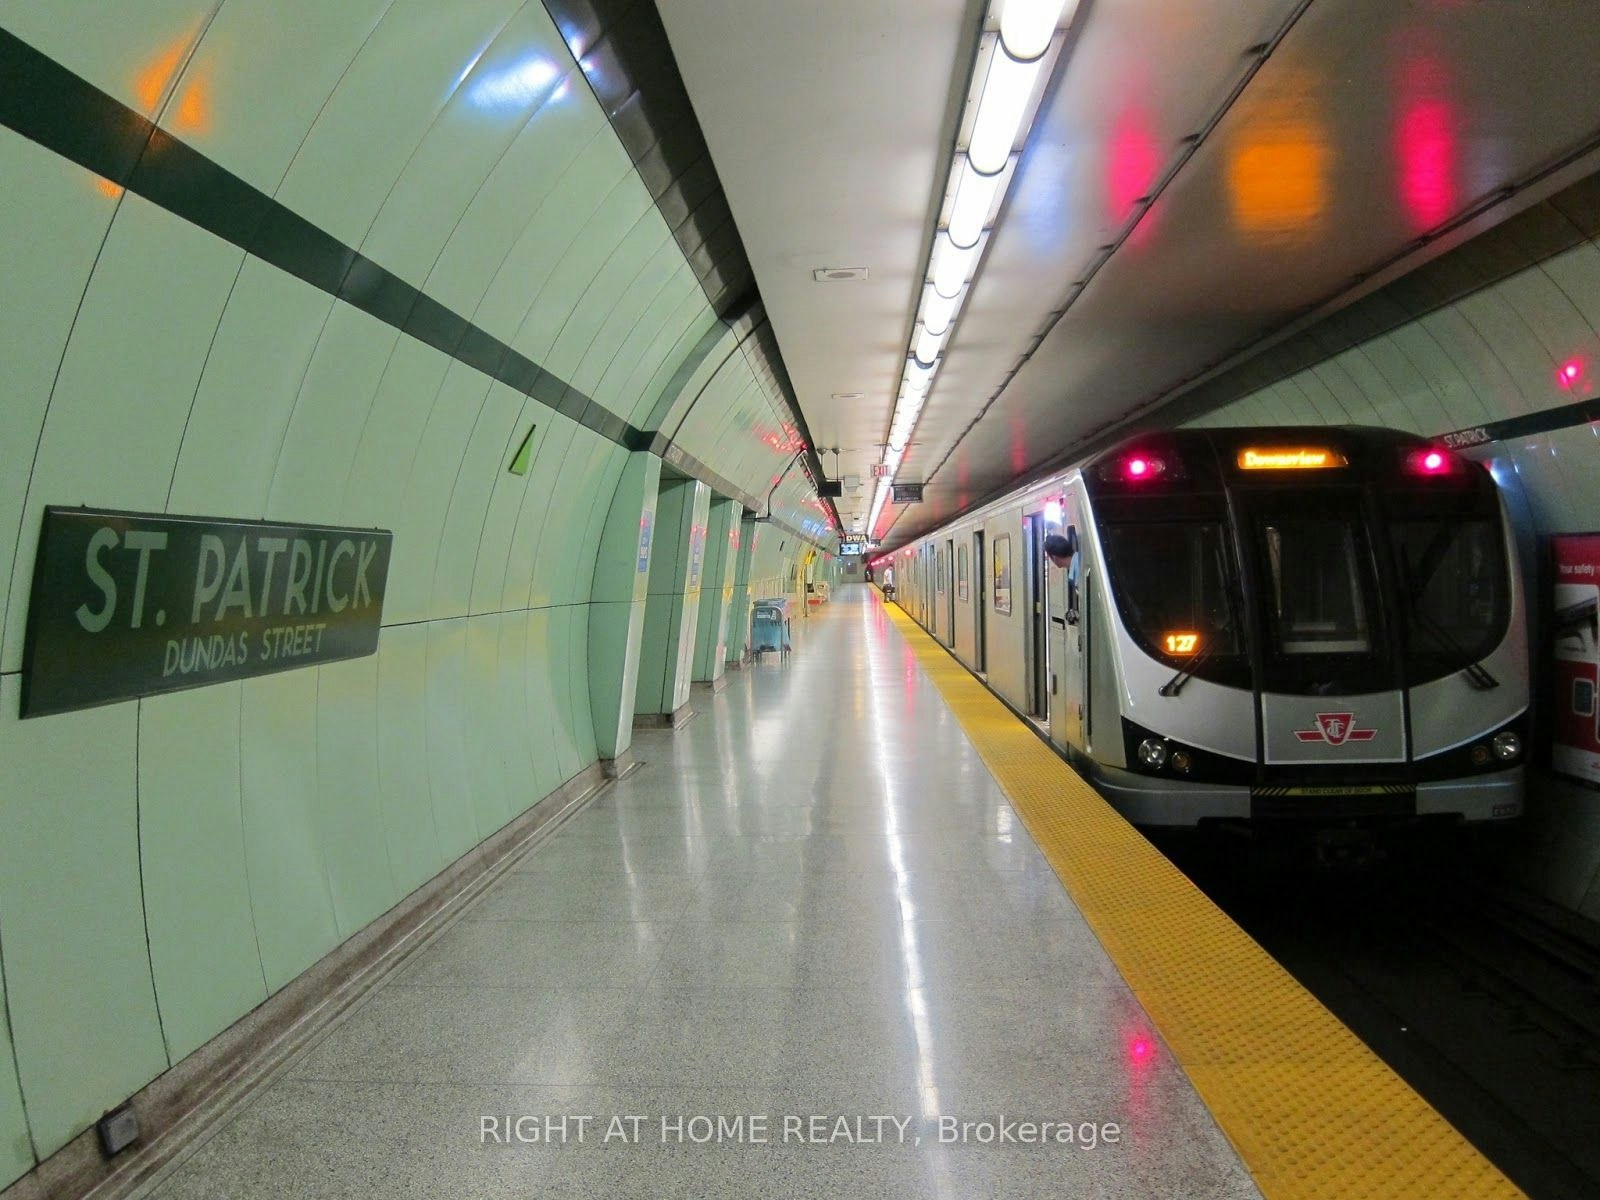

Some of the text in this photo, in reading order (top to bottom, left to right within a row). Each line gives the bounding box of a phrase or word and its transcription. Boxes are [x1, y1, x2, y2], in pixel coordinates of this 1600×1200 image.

[873, 465, 889, 477] EXIT
[1574, 563, 1595, 577] safety
[75, 526, 378, 633] ST. PATRICK
[162, 622, 328, 678] DUNDAS STREET
[1166, 634, 1198, 652] 127
